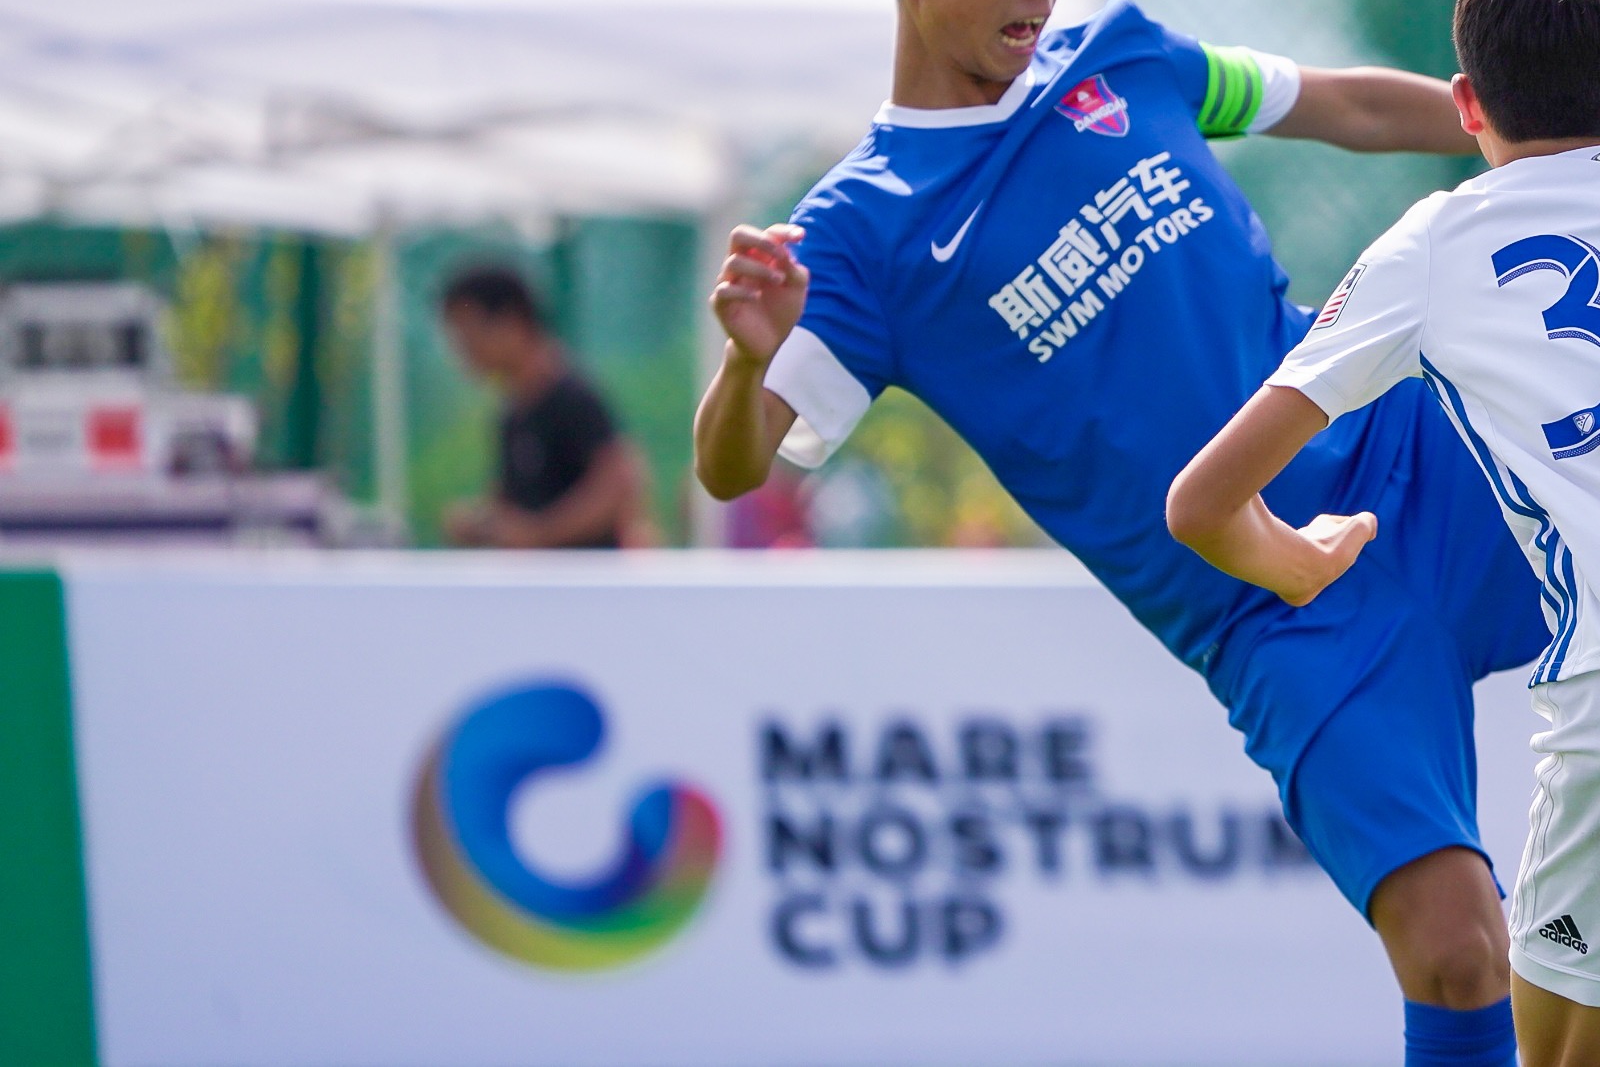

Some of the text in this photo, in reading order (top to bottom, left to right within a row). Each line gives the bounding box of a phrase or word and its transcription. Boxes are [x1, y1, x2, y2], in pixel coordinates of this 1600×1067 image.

[988, 151, 1191, 339] 斯威汽车
[1028, 198, 1215, 363] SWM MOTORS
[758, 717, 1094, 786] MARE
[767, 897, 1004, 970] CUP
[1538, 927, 1589, 955] adidas
